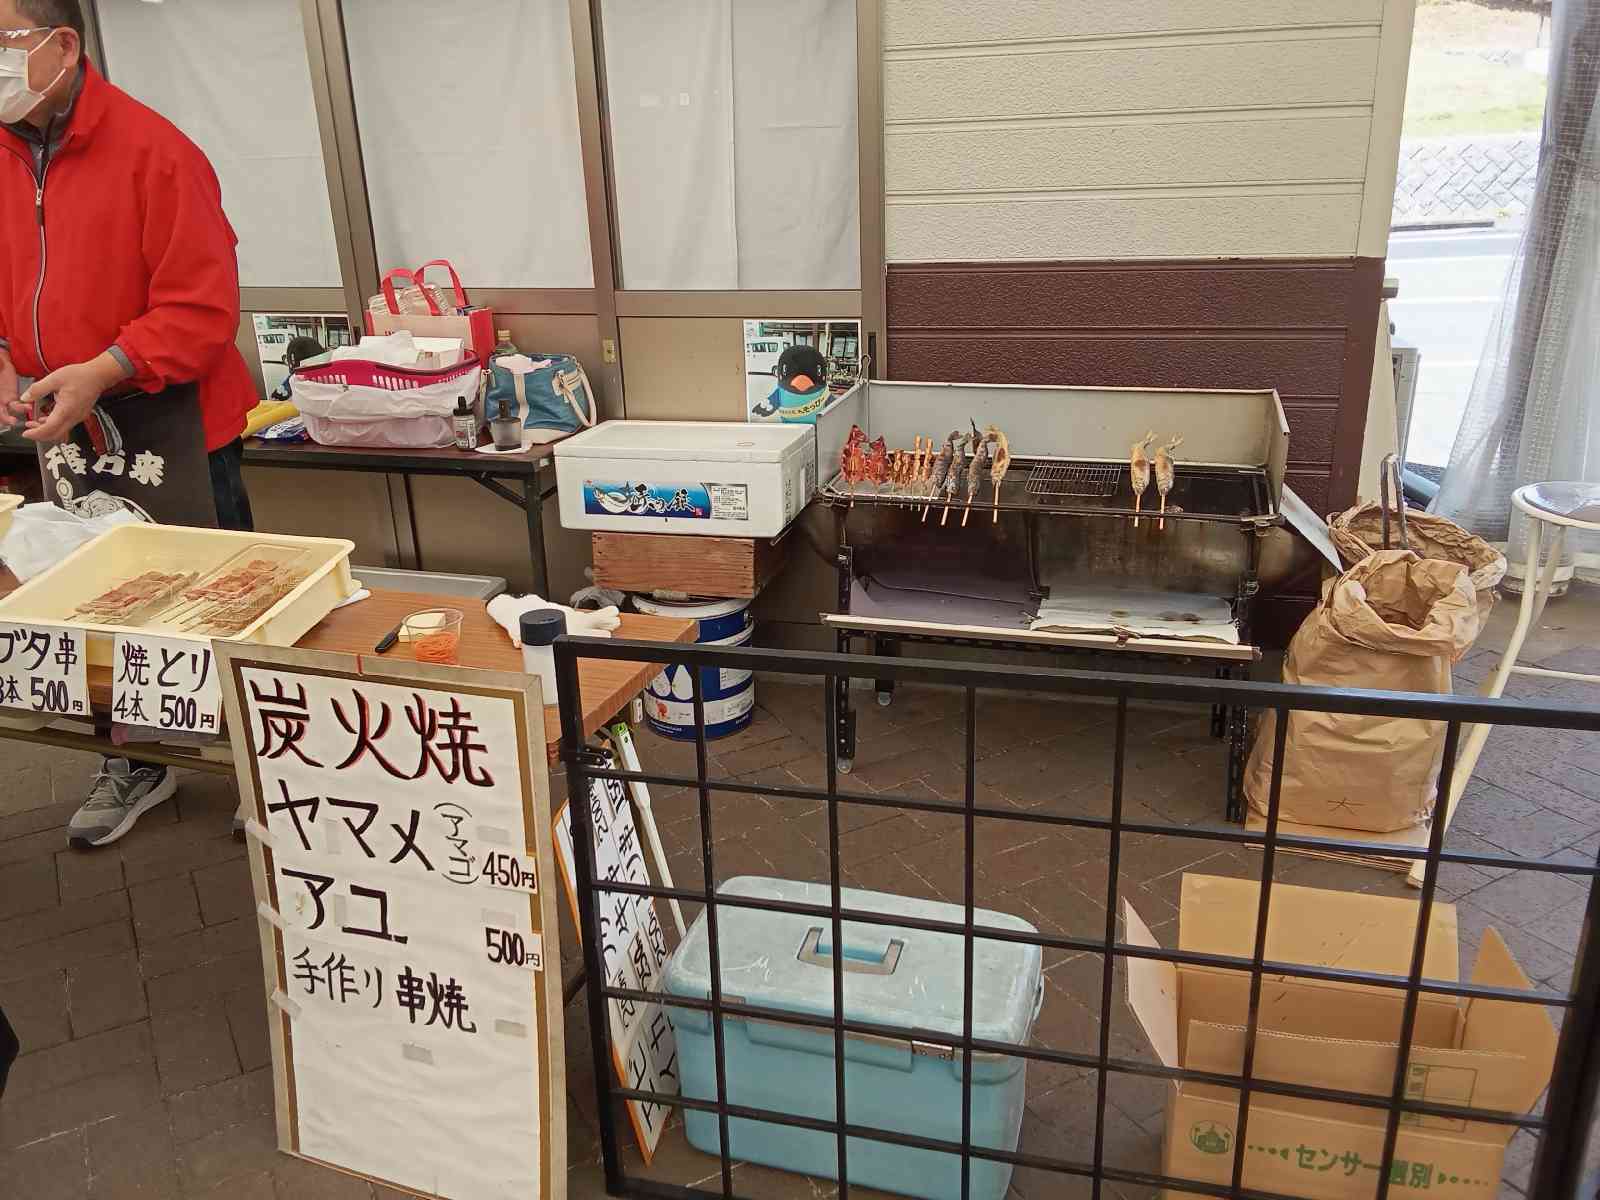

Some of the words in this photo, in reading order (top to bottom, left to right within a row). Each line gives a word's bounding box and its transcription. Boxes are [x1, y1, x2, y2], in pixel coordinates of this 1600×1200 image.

[0, 628, 78, 676] ブタ串
[117, 639, 212, 693] 焼とり
[30, 676, 84, 713] 500円
[113, 690, 150, 722] 4本
[159, 694, 215, 729] 500円
[249, 678, 496, 788] 炭火焼
[267, 778, 436, 872] ヤマメ
[482, 850, 536, 889] 450円
[281, 867, 409, 945] アユ
[485, 926, 540, 968] 500円
